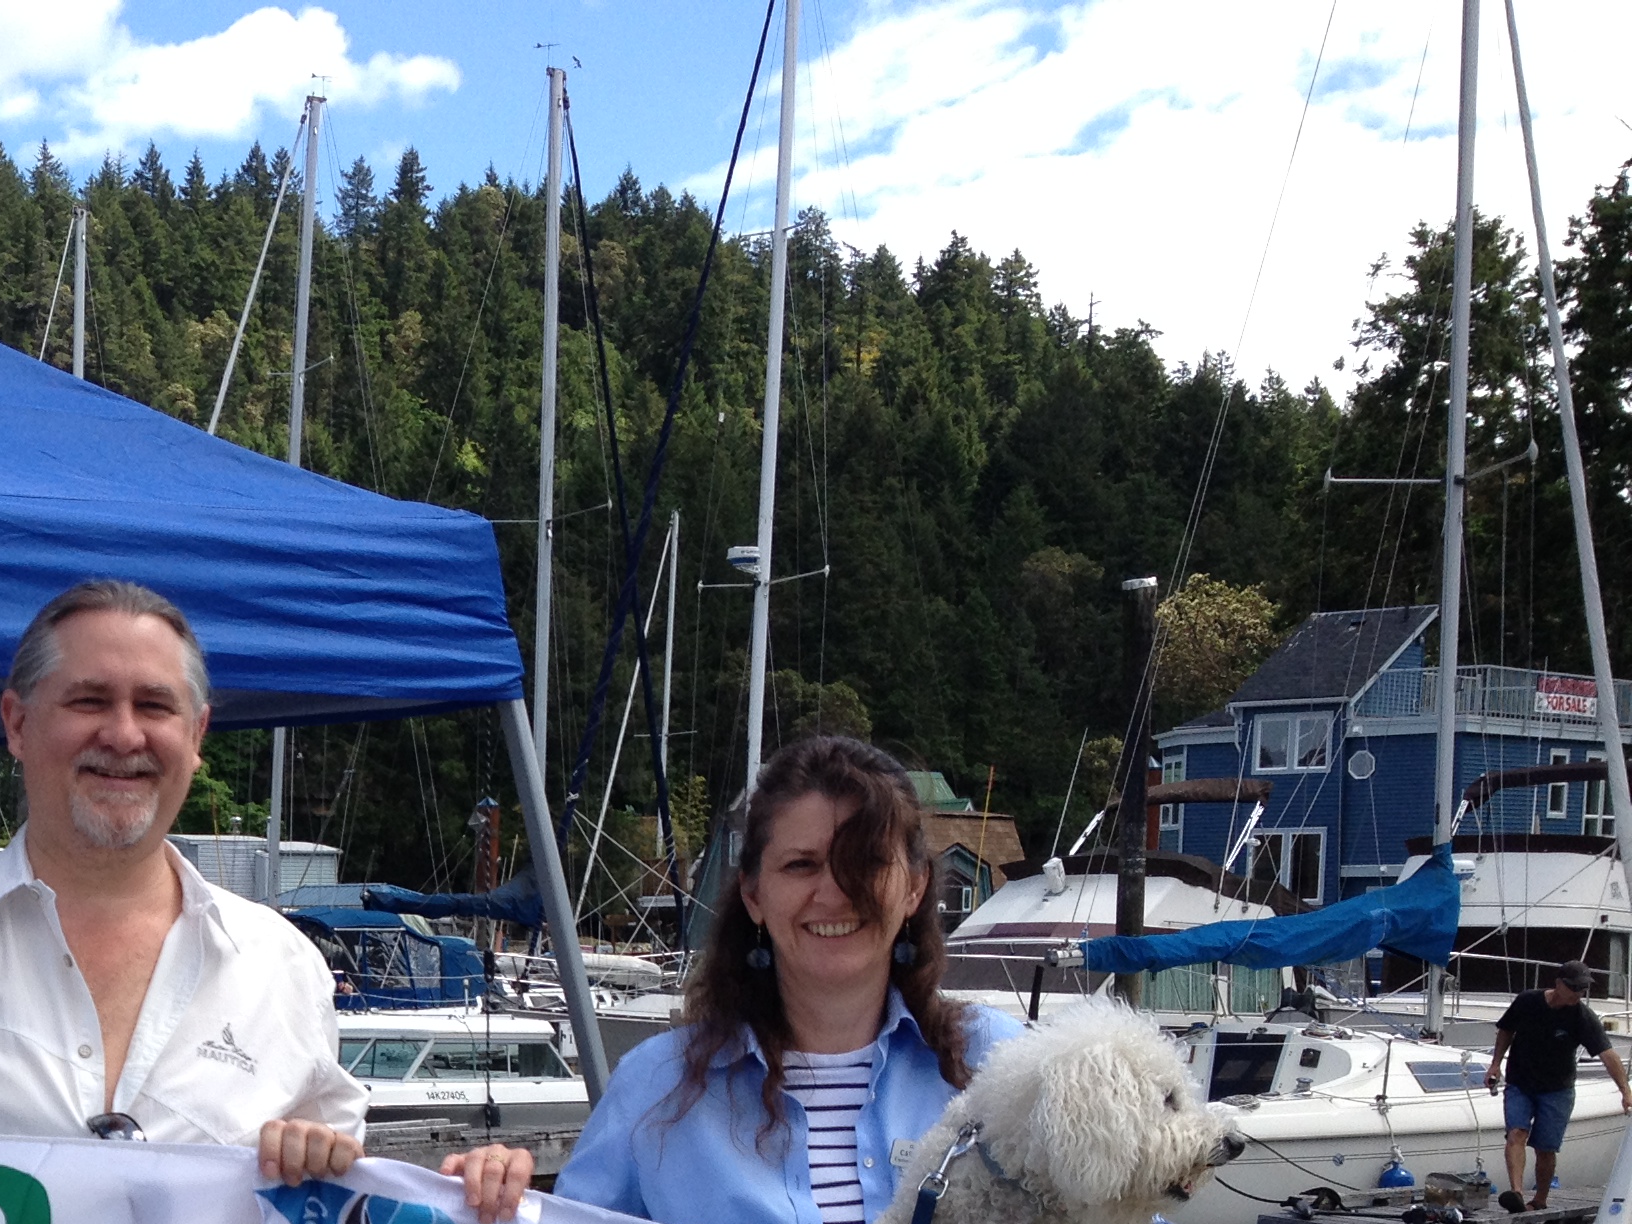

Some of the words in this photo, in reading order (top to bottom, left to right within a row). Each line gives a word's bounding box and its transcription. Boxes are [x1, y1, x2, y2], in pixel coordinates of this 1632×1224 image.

[1546, 695, 1565, 711] FOR
[1564, 697, 1587, 713] SALE
[196, 1047, 256, 1076] NAUTICA
